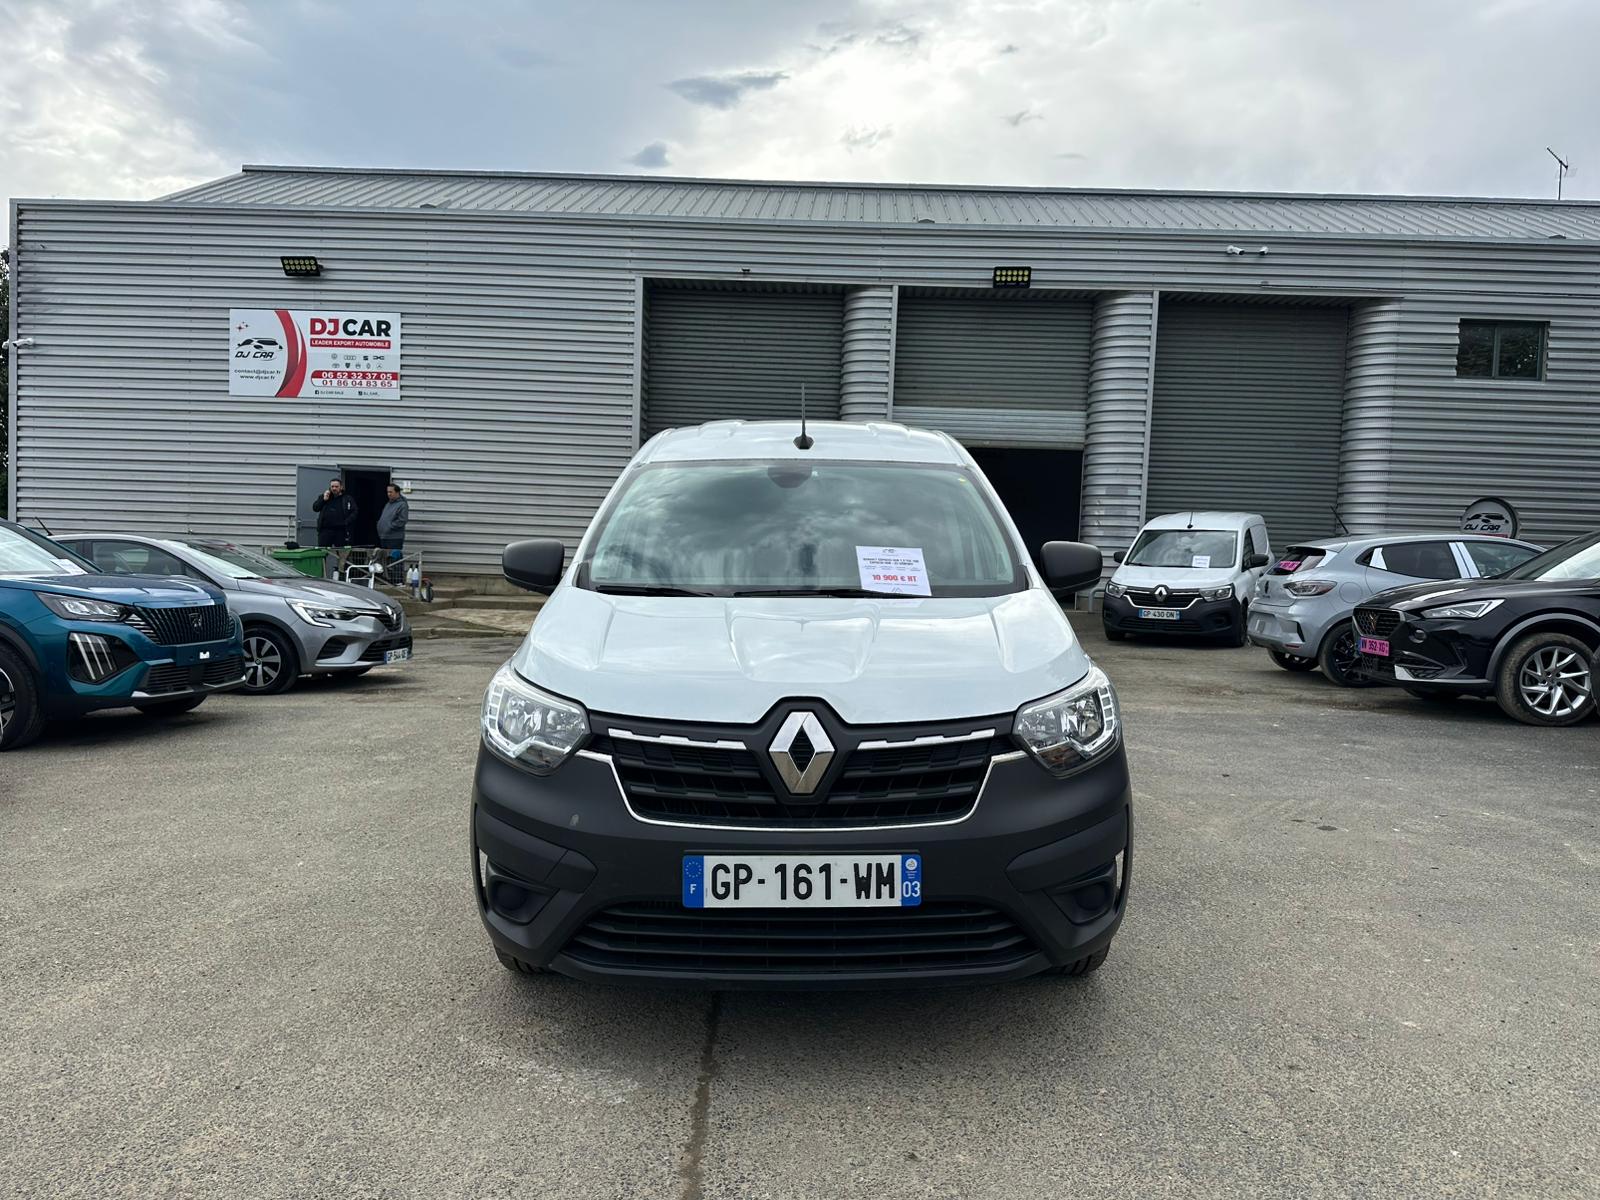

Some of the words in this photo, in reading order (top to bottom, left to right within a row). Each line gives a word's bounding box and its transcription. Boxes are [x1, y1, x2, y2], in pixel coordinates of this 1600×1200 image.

[310, 318, 339, 336] DJ
[342, 319, 391, 337] CAR
[690, 883, 697, 894] F
[711, 862, 895, 900] GP-161-WM
[902, 881, 920, 898] 03
